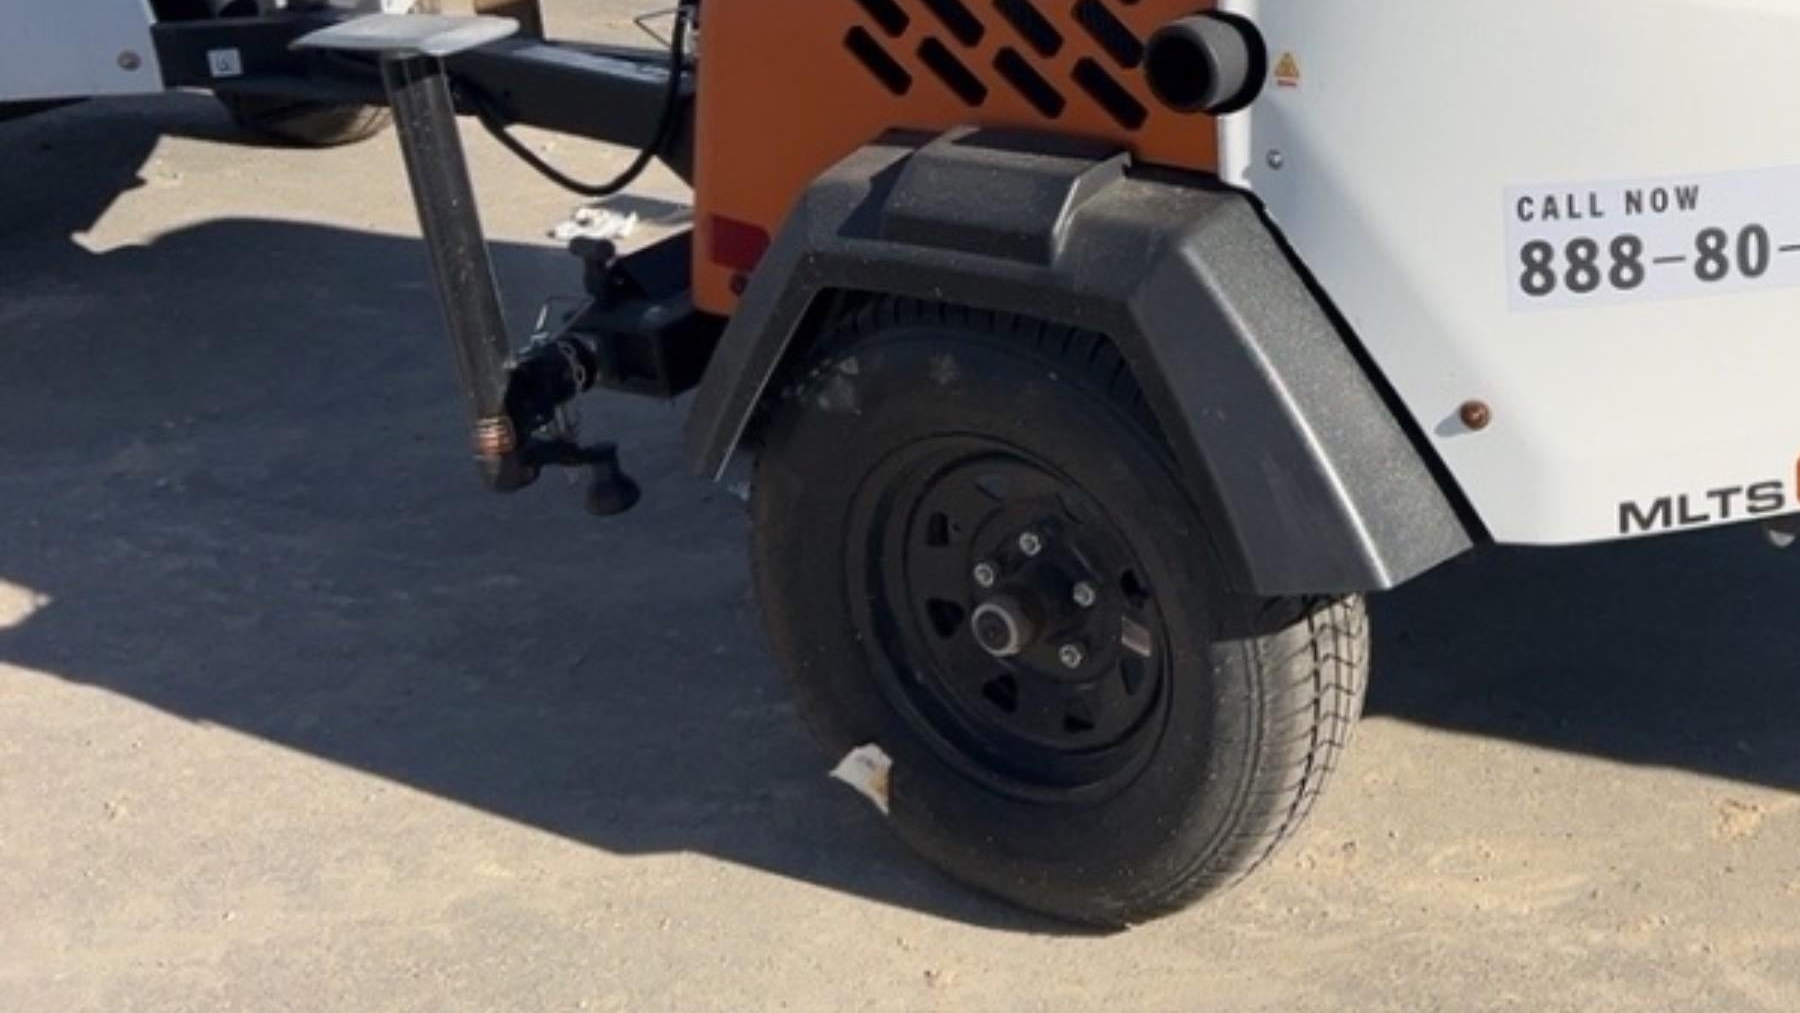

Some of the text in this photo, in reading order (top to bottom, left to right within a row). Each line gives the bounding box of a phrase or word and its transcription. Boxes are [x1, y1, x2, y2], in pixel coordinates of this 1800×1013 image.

[1516, 185, 1702, 223] CALL NOW
[1618, 480, 1785, 533] MLTS
